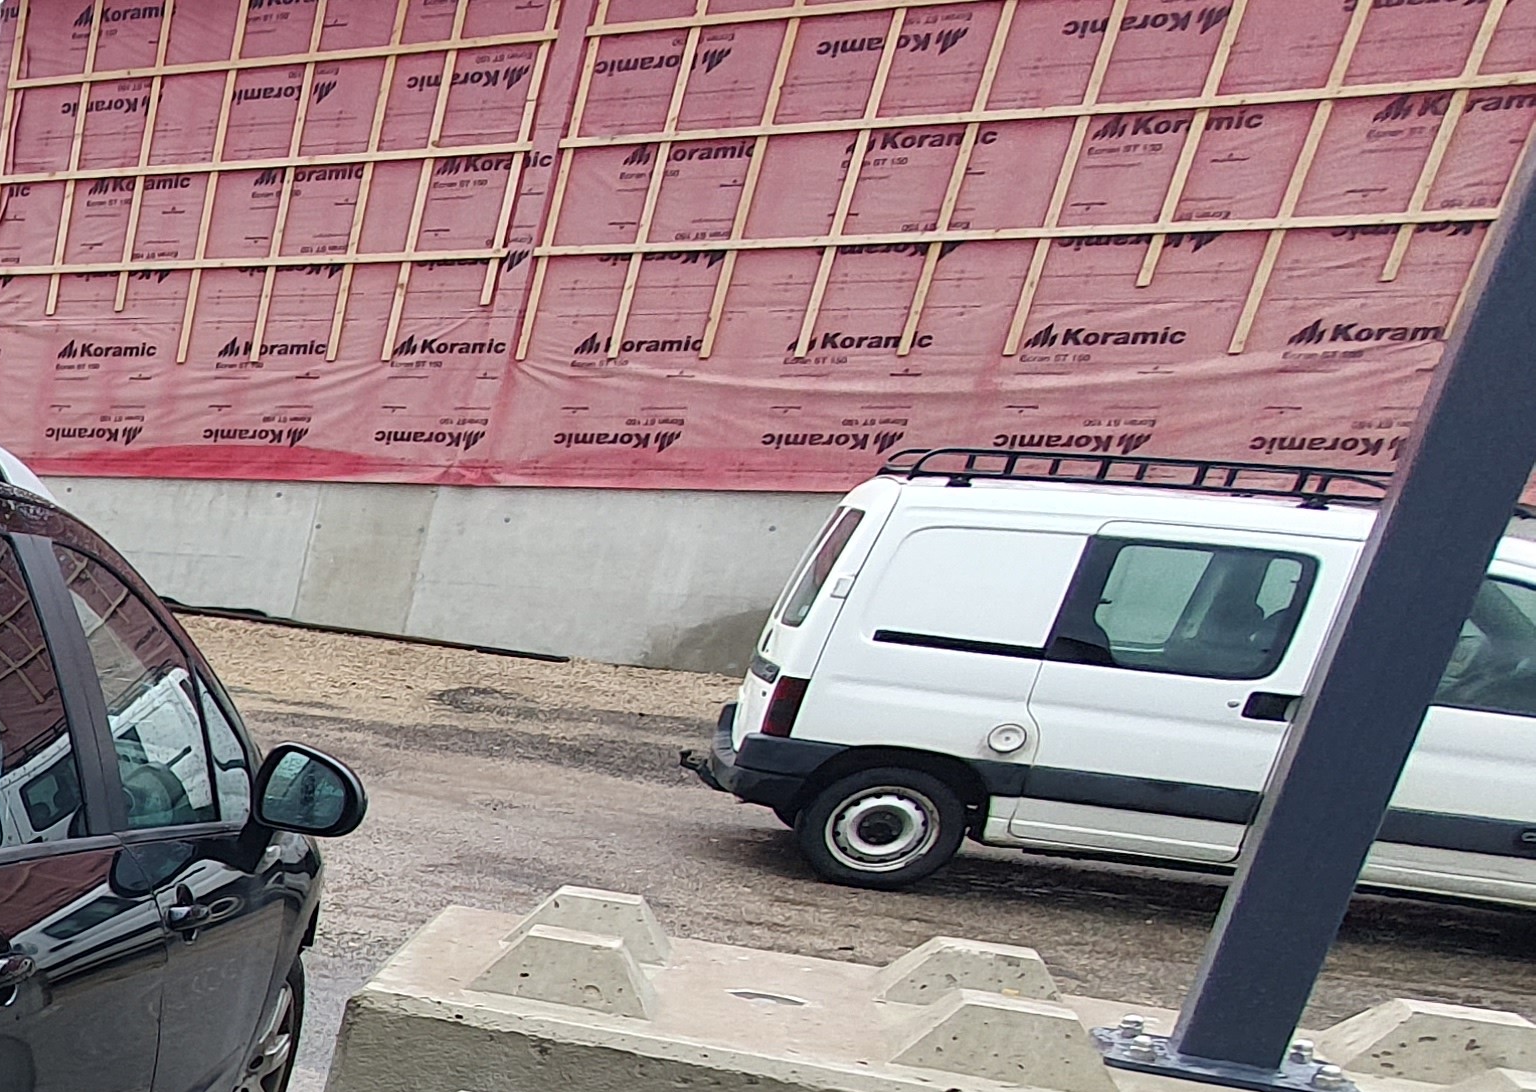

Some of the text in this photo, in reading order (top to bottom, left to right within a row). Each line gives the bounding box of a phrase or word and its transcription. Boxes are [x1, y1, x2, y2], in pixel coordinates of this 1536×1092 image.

[1061, 326, 1187, 347] Koramic
[80, 342, 157, 358] Koramic
[45, 427, 119, 442] Koramic
[202, 428, 284, 444] Koramic
[374, 430, 460, 448] Koramic
[553, 432, 651, 449] Koramic
[761, 433, 870, 451] Koramic
[993, 434, 1114, 453] Koramic
[1249, 436, 1385, 457] Koramic
